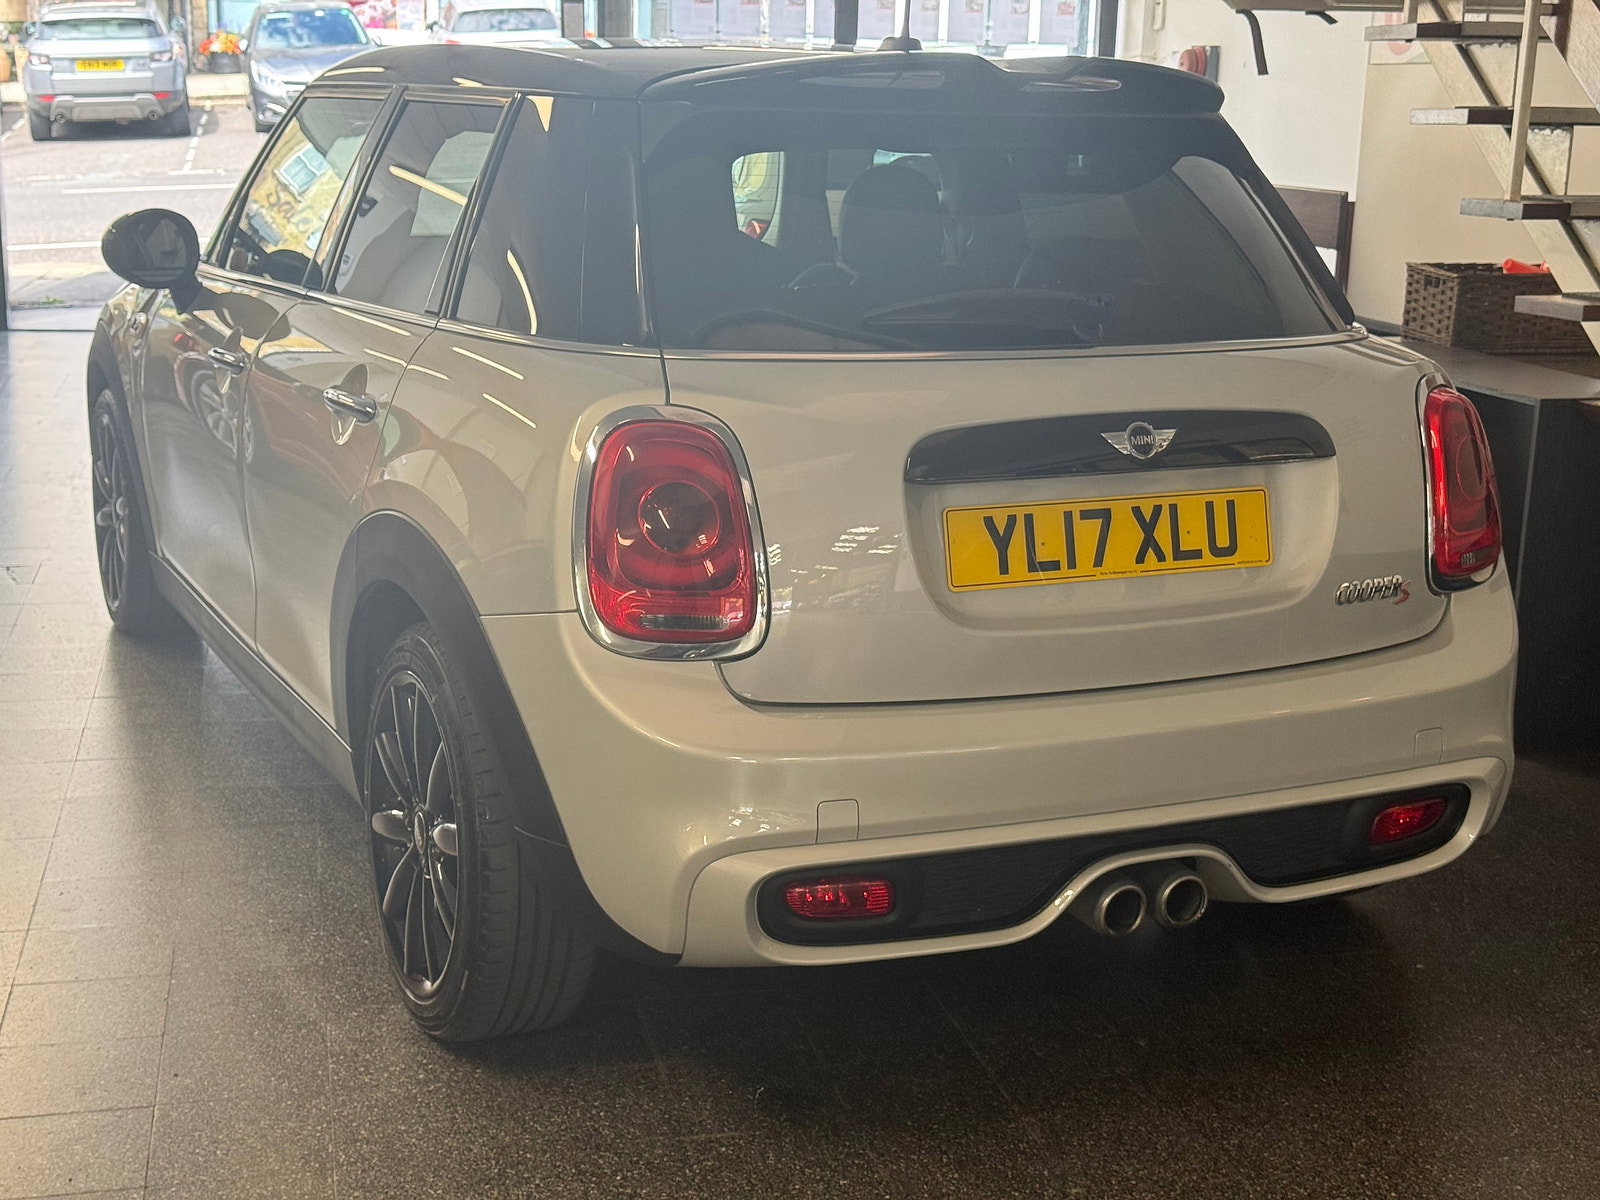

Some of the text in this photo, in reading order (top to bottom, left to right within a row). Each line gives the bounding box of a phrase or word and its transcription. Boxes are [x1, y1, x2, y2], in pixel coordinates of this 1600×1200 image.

[1130, 434, 1154, 446] MINI
[982, 498, 1240, 577] YL17 XLU
[1335, 574, 1413, 605] COOPER S
